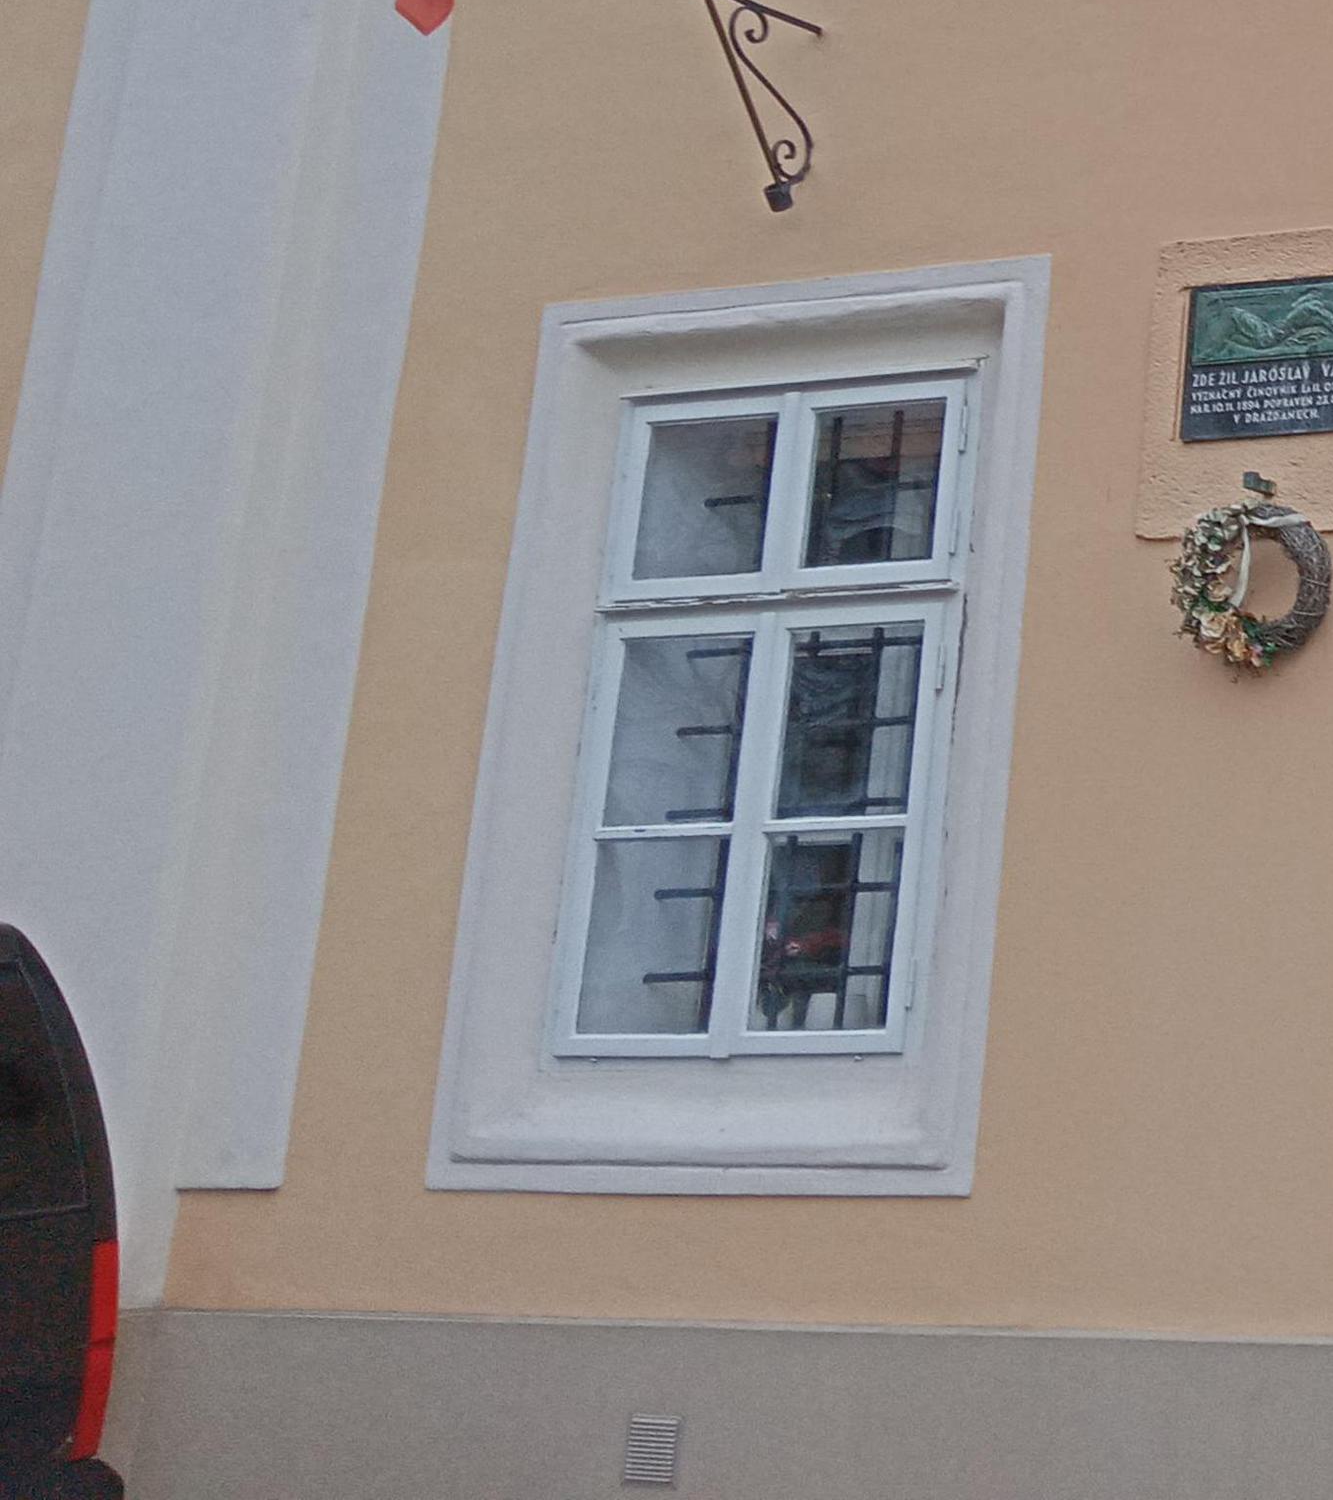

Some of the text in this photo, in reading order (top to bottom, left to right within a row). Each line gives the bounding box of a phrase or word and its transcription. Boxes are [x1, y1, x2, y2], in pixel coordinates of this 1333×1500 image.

[1192, 372, 1216, 387] ZDE
[1241, 362, 1311, 384] JAROSLAV
[1233, 413, 1241, 424] V
